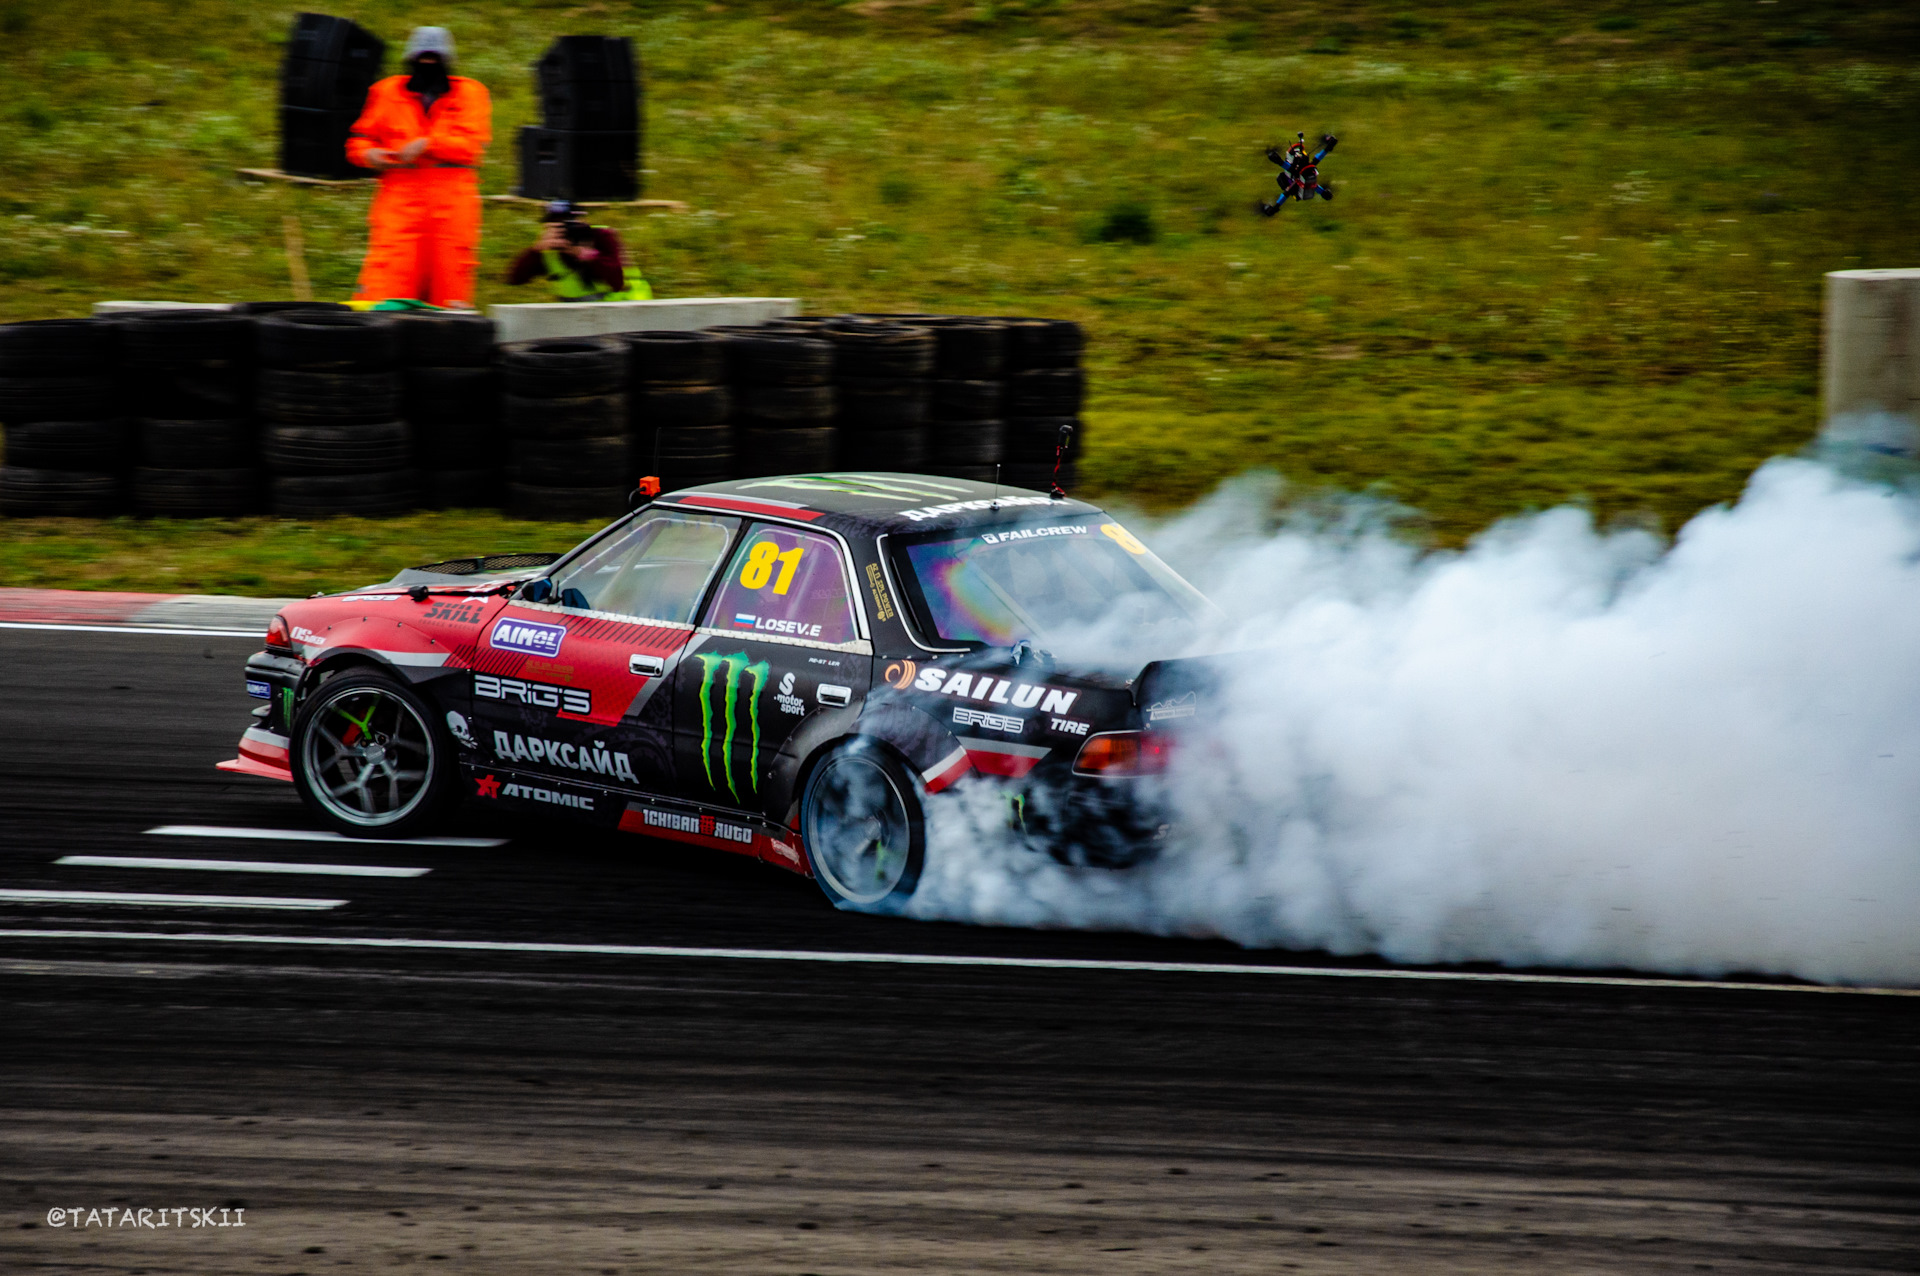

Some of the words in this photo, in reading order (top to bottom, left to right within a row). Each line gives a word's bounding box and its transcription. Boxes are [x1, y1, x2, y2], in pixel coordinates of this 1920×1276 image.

[998, 525, 1088, 542] FAILCREW
[740, 541, 805, 595] 81
[423, 602, 485, 624] SKILL
[494, 624, 557, 647] AIMOL
[755, 617, 822, 637] LOSEV.E
[914, 668, 1078, 715] SAILUN
[780, 703, 805, 716] sport
[1050, 718, 1091, 735] TIRE
[493, 730, 640, 784] ДАРКСАЙД
[502, 783, 595, 811] ATOMIC
[714, 822, 752, 844] AUTO
